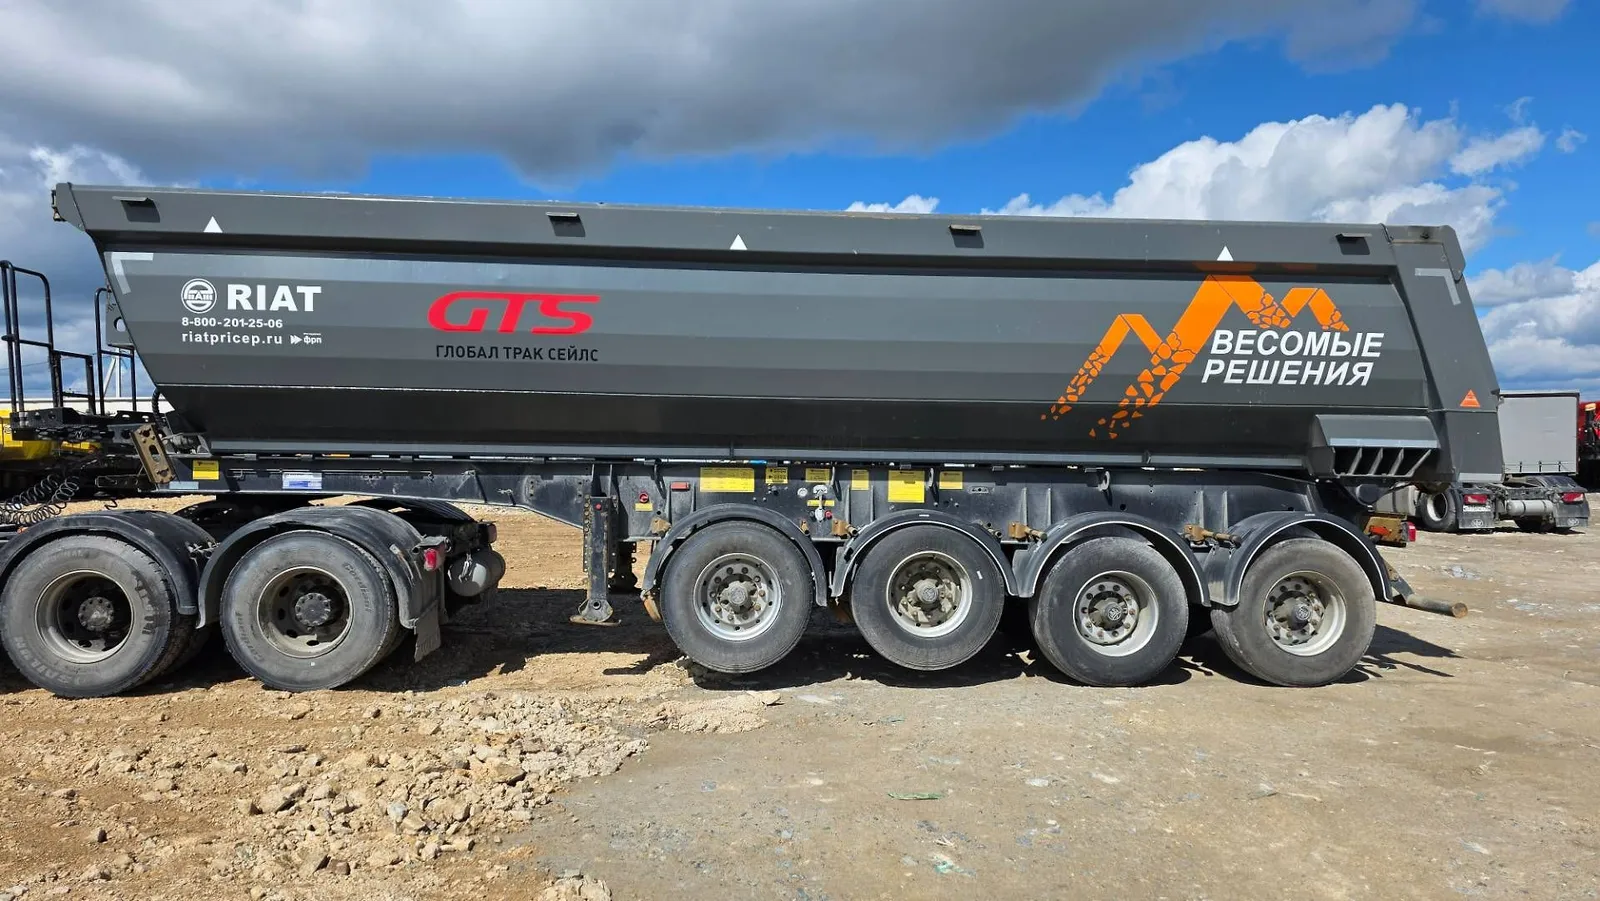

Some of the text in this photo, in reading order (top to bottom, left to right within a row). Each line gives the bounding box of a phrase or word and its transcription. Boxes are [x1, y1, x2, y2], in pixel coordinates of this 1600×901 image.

[227, 283, 322, 312] RIAT
[181, 317, 283, 328] 8-800-201-25-06
[427, 290, 601, 336] GTS
[181, 331, 283, 346] riatpricep.ru
[1210, 329, 1385, 358] ВЕСОМЫЕ
[436, 345, 599, 362] ГЛОБАЛ ТРАК СЕЙЛС
[1201, 359, 1374, 386] РЕШЕНИЯ
